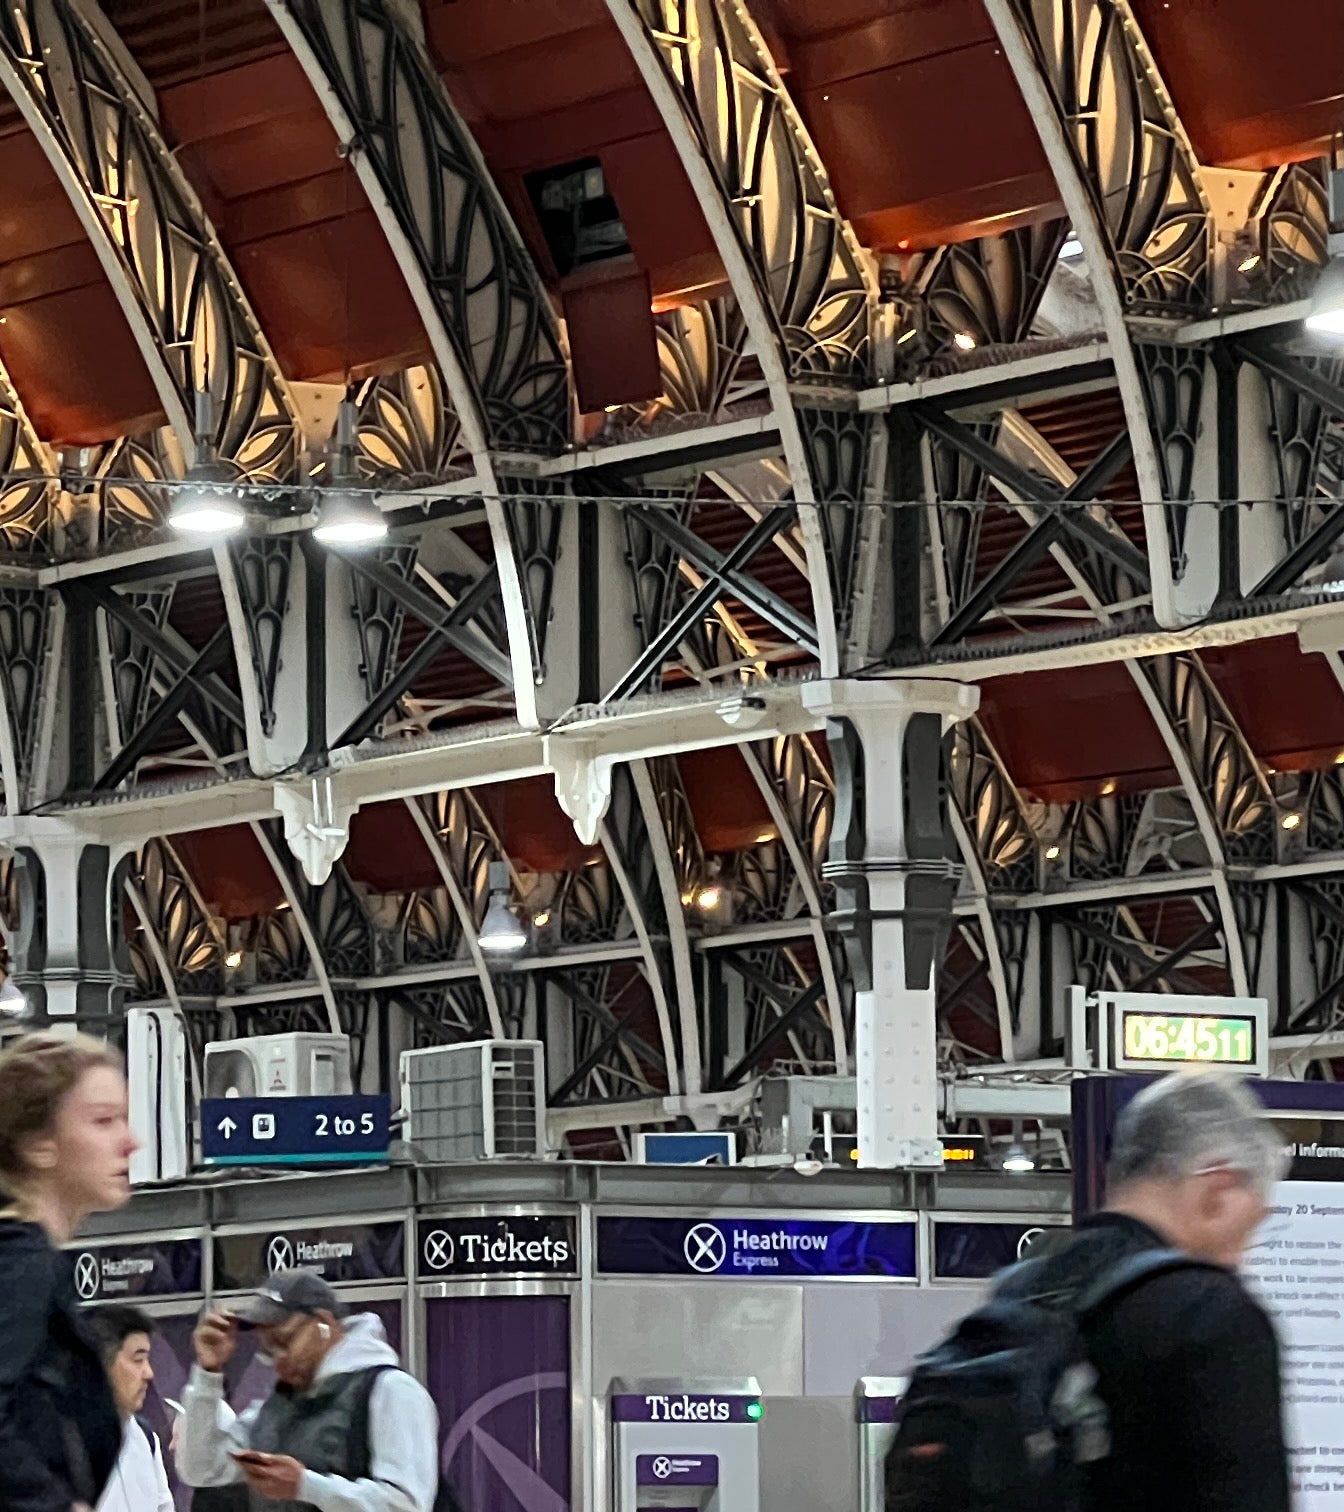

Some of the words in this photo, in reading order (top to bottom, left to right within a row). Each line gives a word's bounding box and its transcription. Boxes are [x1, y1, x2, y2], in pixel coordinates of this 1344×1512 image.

[315, 1114, 329, 1136] 2
[335, 1116, 355, 1136] to
[361, 1113, 374, 1135] 5
[1296, 1204, 1308, 1214] 20
[460, 1233, 568, 1264] Tickets
[733, 1229, 828, 1250] Heathrow
[297, 1241, 353, 1260] Heathrow
[733, 1251, 779, 1272] Express
[646, 1395, 730, 1422] Tickets
